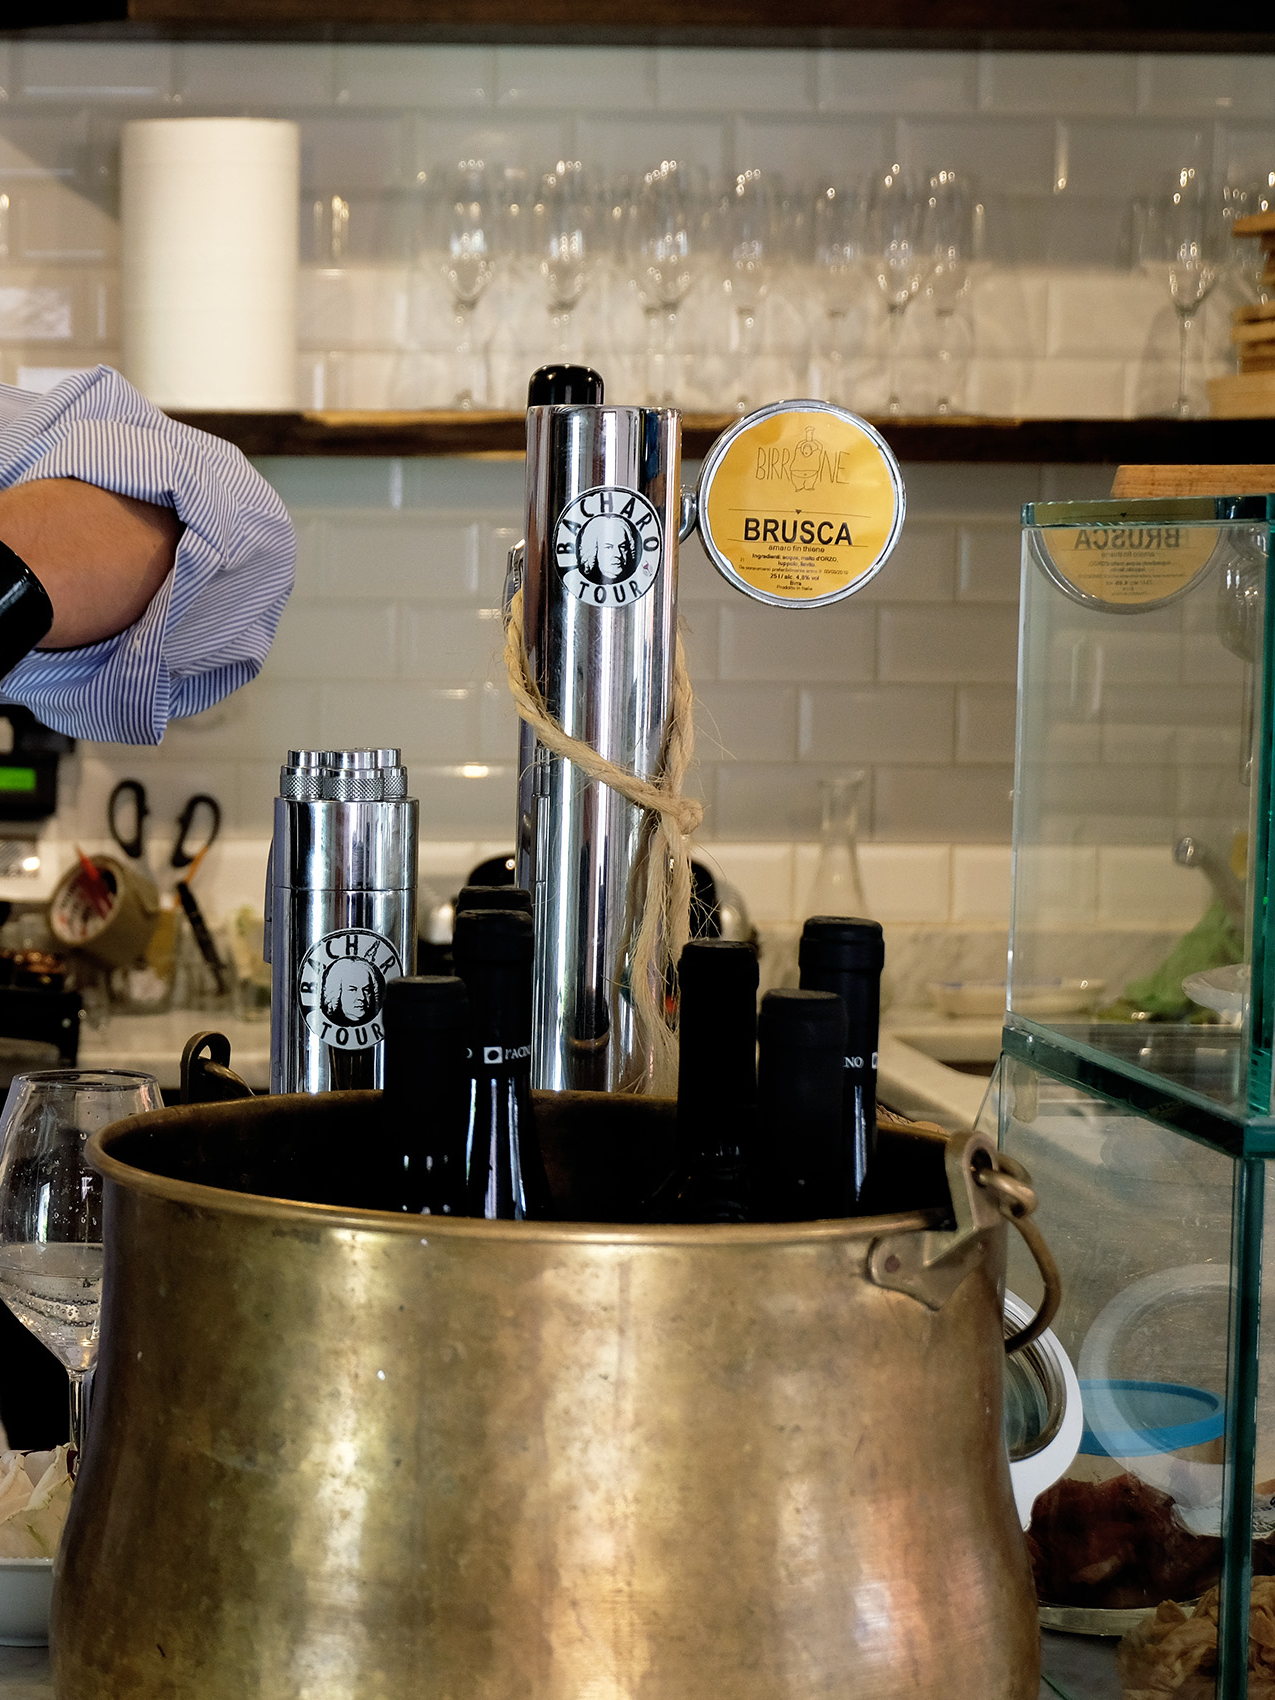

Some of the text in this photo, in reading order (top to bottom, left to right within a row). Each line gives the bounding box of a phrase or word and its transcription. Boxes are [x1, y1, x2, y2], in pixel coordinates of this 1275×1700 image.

[557, 492, 659, 554] BACHARO
[744, 517, 853, 546] BRUSCA
[578, 580, 642, 604] TOUR
[301, 935, 397, 994] BACHAR
[320, 1022, 385, 1046] TOUR
